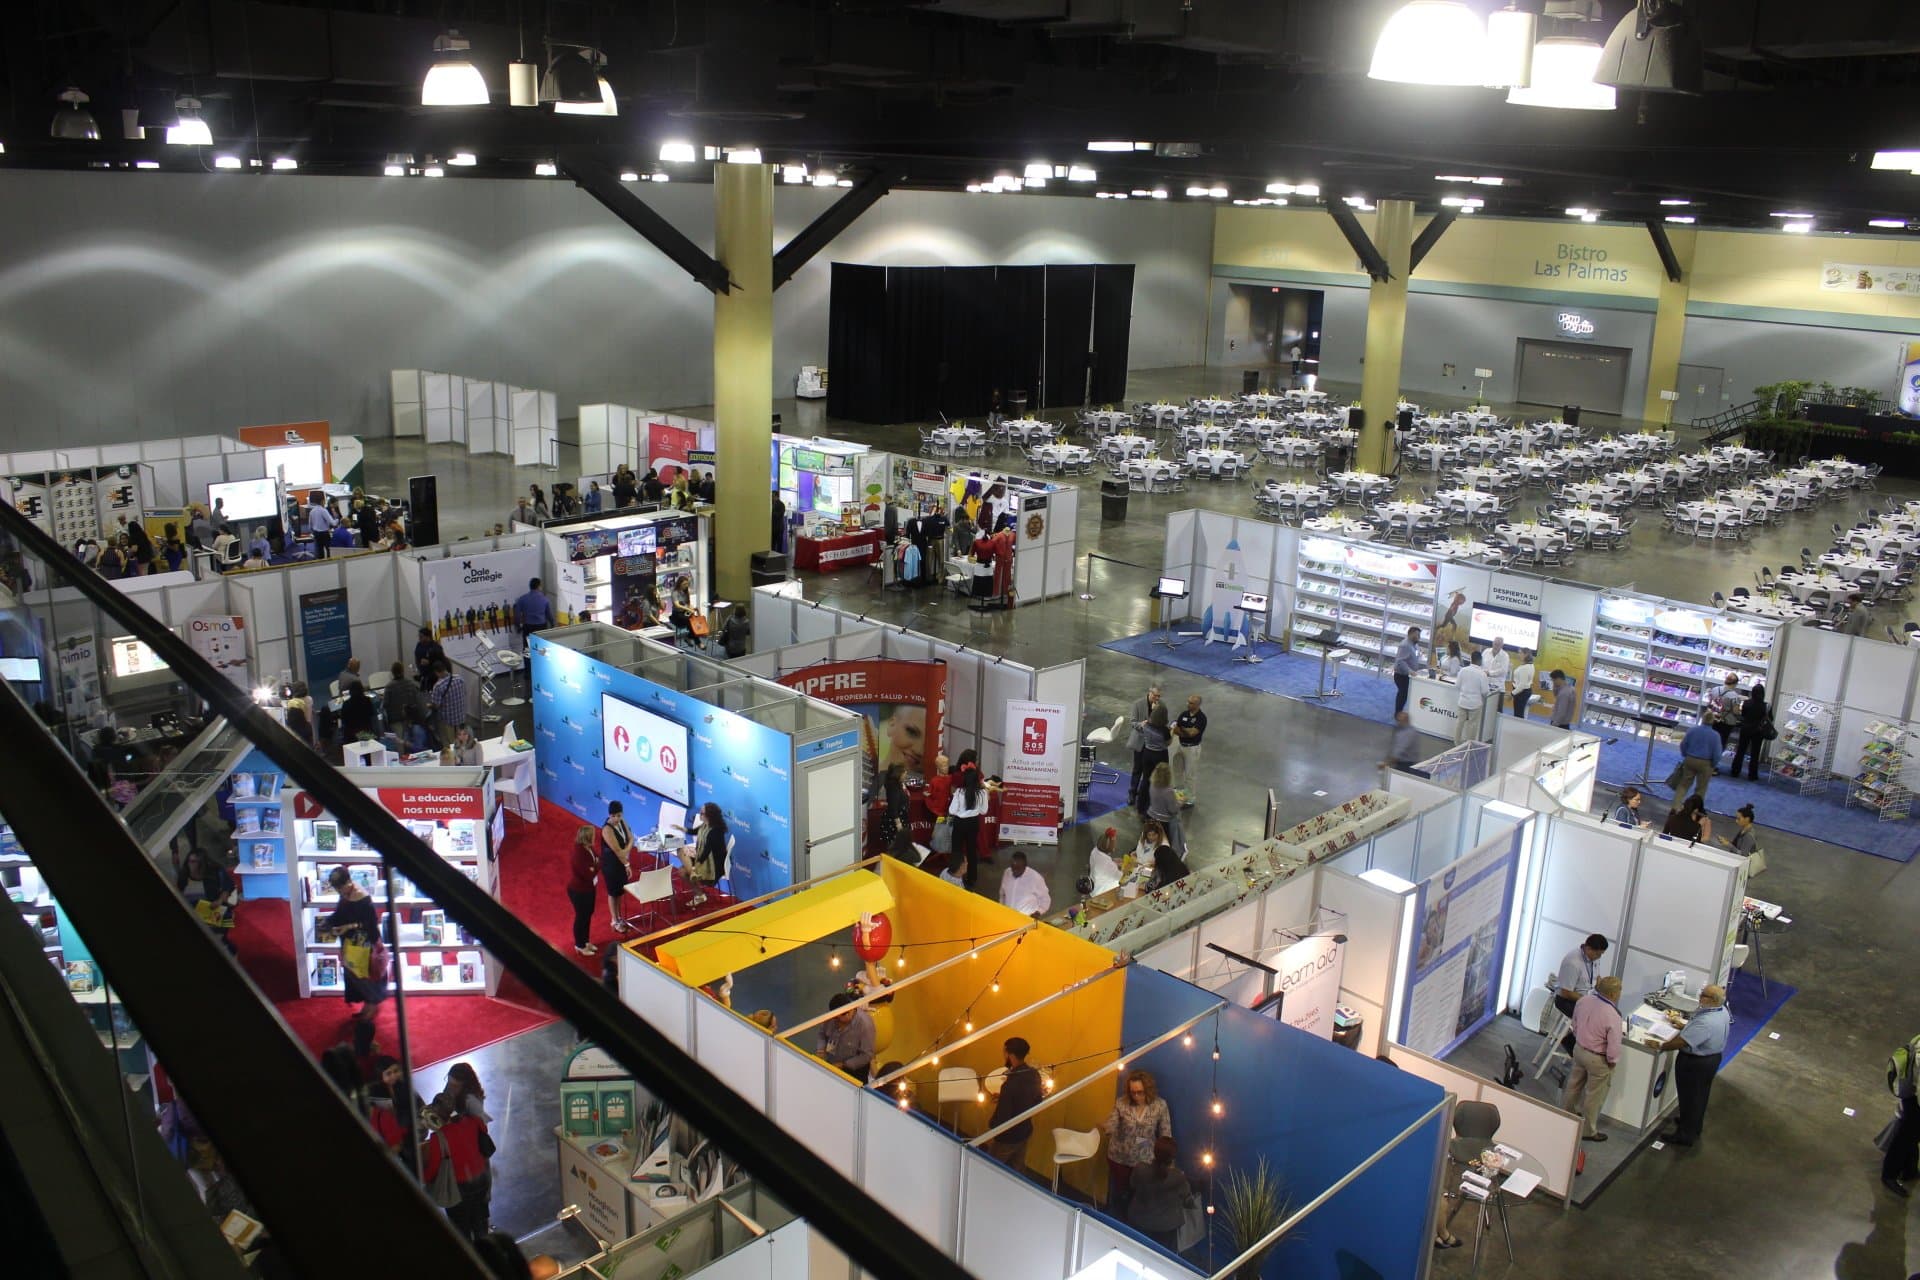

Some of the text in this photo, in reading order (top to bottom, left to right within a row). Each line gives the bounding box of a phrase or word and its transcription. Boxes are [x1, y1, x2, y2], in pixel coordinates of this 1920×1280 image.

[1557, 243, 1608, 263] Bistro
[1534, 259, 1629, 282] Las Palmas
[463, 572, 503, 584] Carnegie
[470, 567, 490, 577] Dale
[1493, 587, 1528, 599] DESPIERTA
[1495, 594, 1532, 607] POTENCIAL
[192, 620, 231, 632] Osmo
[789, 671, 867, 695] APFRE
[835, 693, 873, 702] PROPIEDAD
[910, 694, 926, 702] VIDA
[1430, 705, 1458, 719] SANTILL
[402, 792, 474, 803] La educación
[403, 806, 462, 814] nos mueve
[1279, 961, 1316, 990] learn
[1317, 942, 1337, 970] aid
